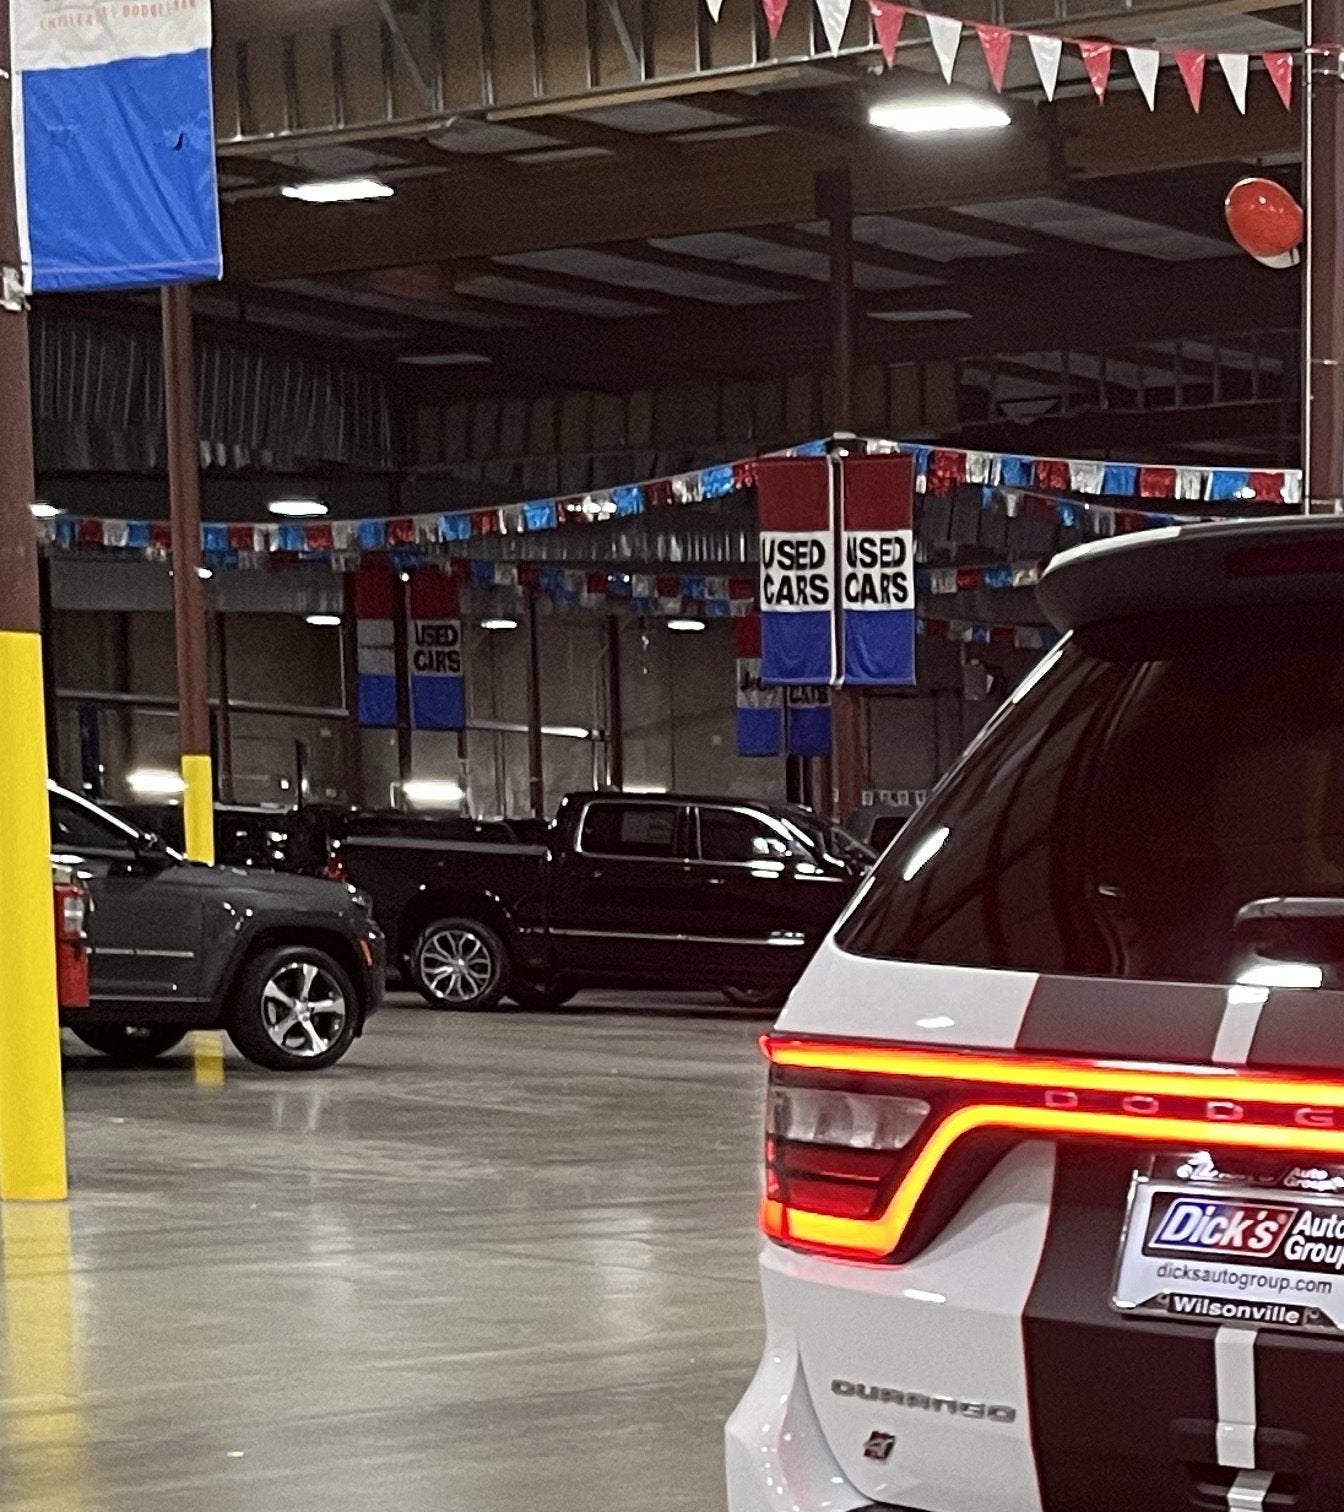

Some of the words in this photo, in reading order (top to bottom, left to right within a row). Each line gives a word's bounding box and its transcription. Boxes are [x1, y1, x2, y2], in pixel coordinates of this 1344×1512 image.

[762, 538, 826, 570] USED
[847, 537, 906, 568] USED
[763, 573, 829, 605] CARS
[845, 572, 908, 604] CARS
[416, 624, 458, 647] USED
[414, 650, 461, 672] CARS
[1160, 1205, 1279, 1250] Dick's
[1156, 1262, 1333, 1295] dicksautogroup.com
[1174, 1296, 1301, 1325] Wilsonville
[830, 1378, 1017, 1424] DURANGO
